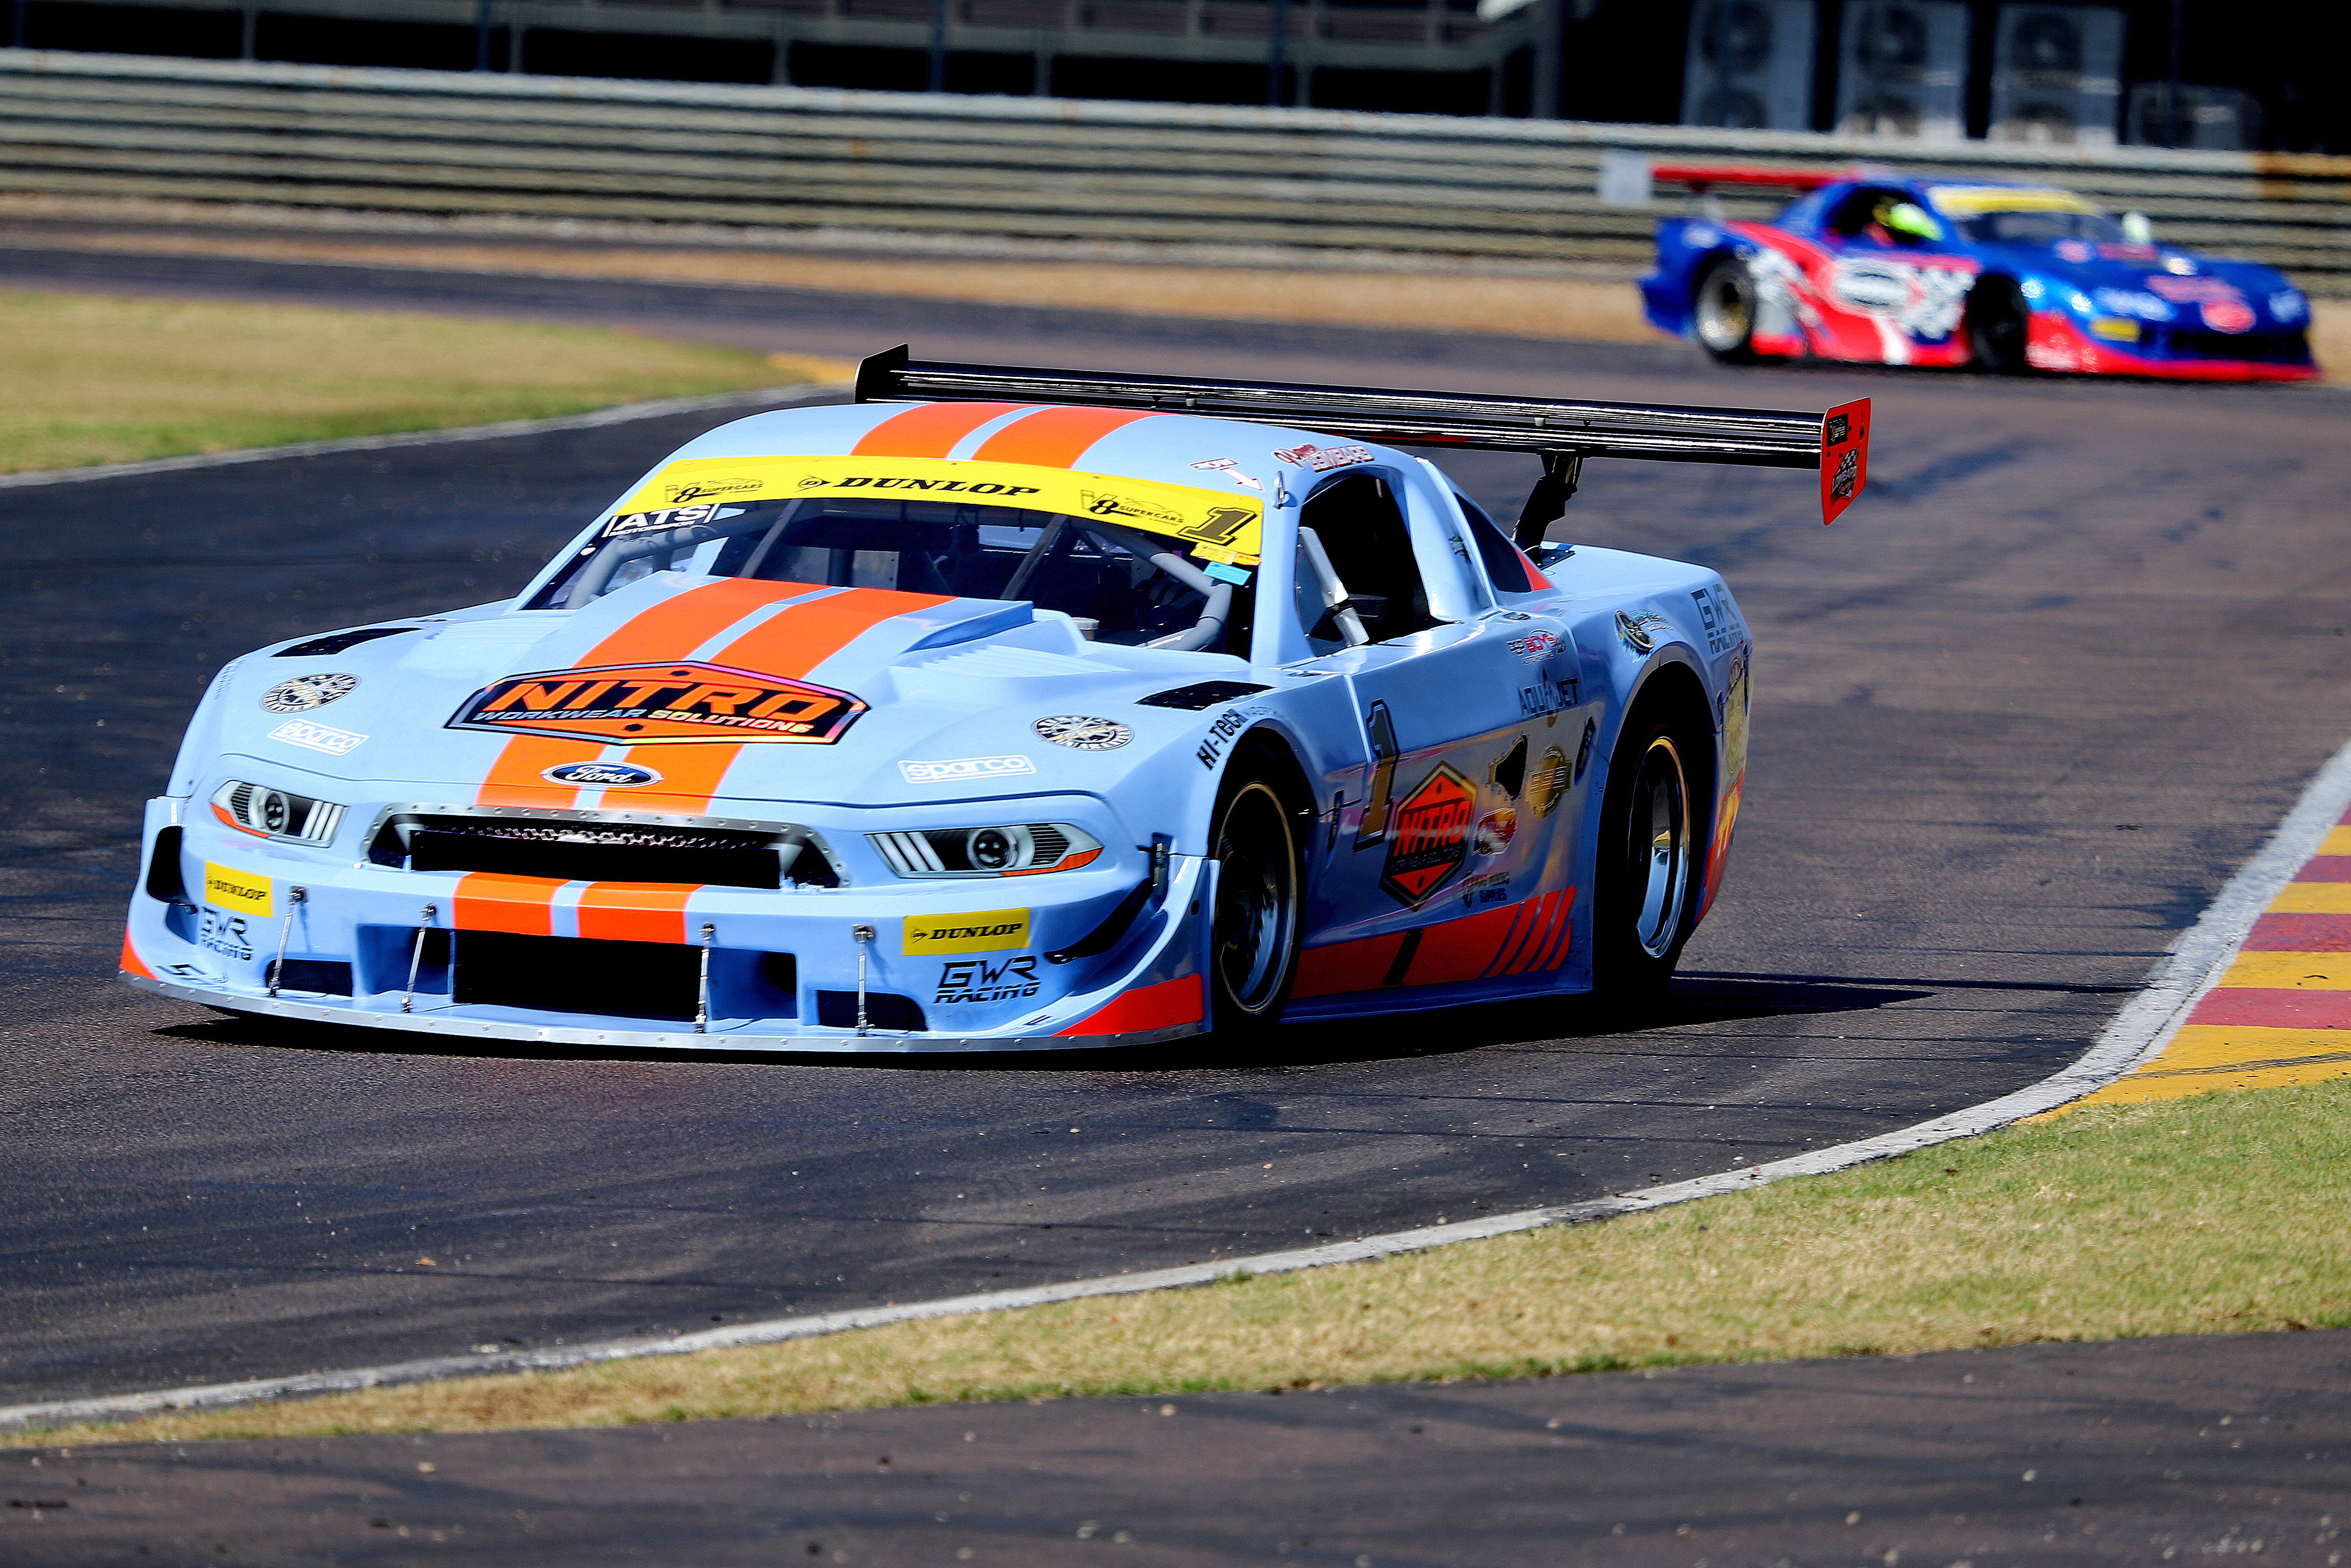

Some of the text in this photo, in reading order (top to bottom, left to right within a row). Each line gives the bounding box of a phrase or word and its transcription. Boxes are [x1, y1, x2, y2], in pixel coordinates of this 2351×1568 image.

[832, 478, 1040, 496] DUNLOP
[1118, 505, 1185, 523] SUPERCARS
[1177, 507, 1257, 546] 1
[483, 681, 840, 721] NITRO
[475, 709, 814, 733] WORKWEAR SOLUTIONS
[273, 723, 361, 748] sparco
[565, 765, 635, 784] Ford
[908, 755, 1027, 776] sparco
[1393, 801, 1471, 857] NITRO
[928, 923, 1023, 940] DUNLOP
[940, 956, 1039, 988] GWR
[935, 982, 1040, 1004] RACING
